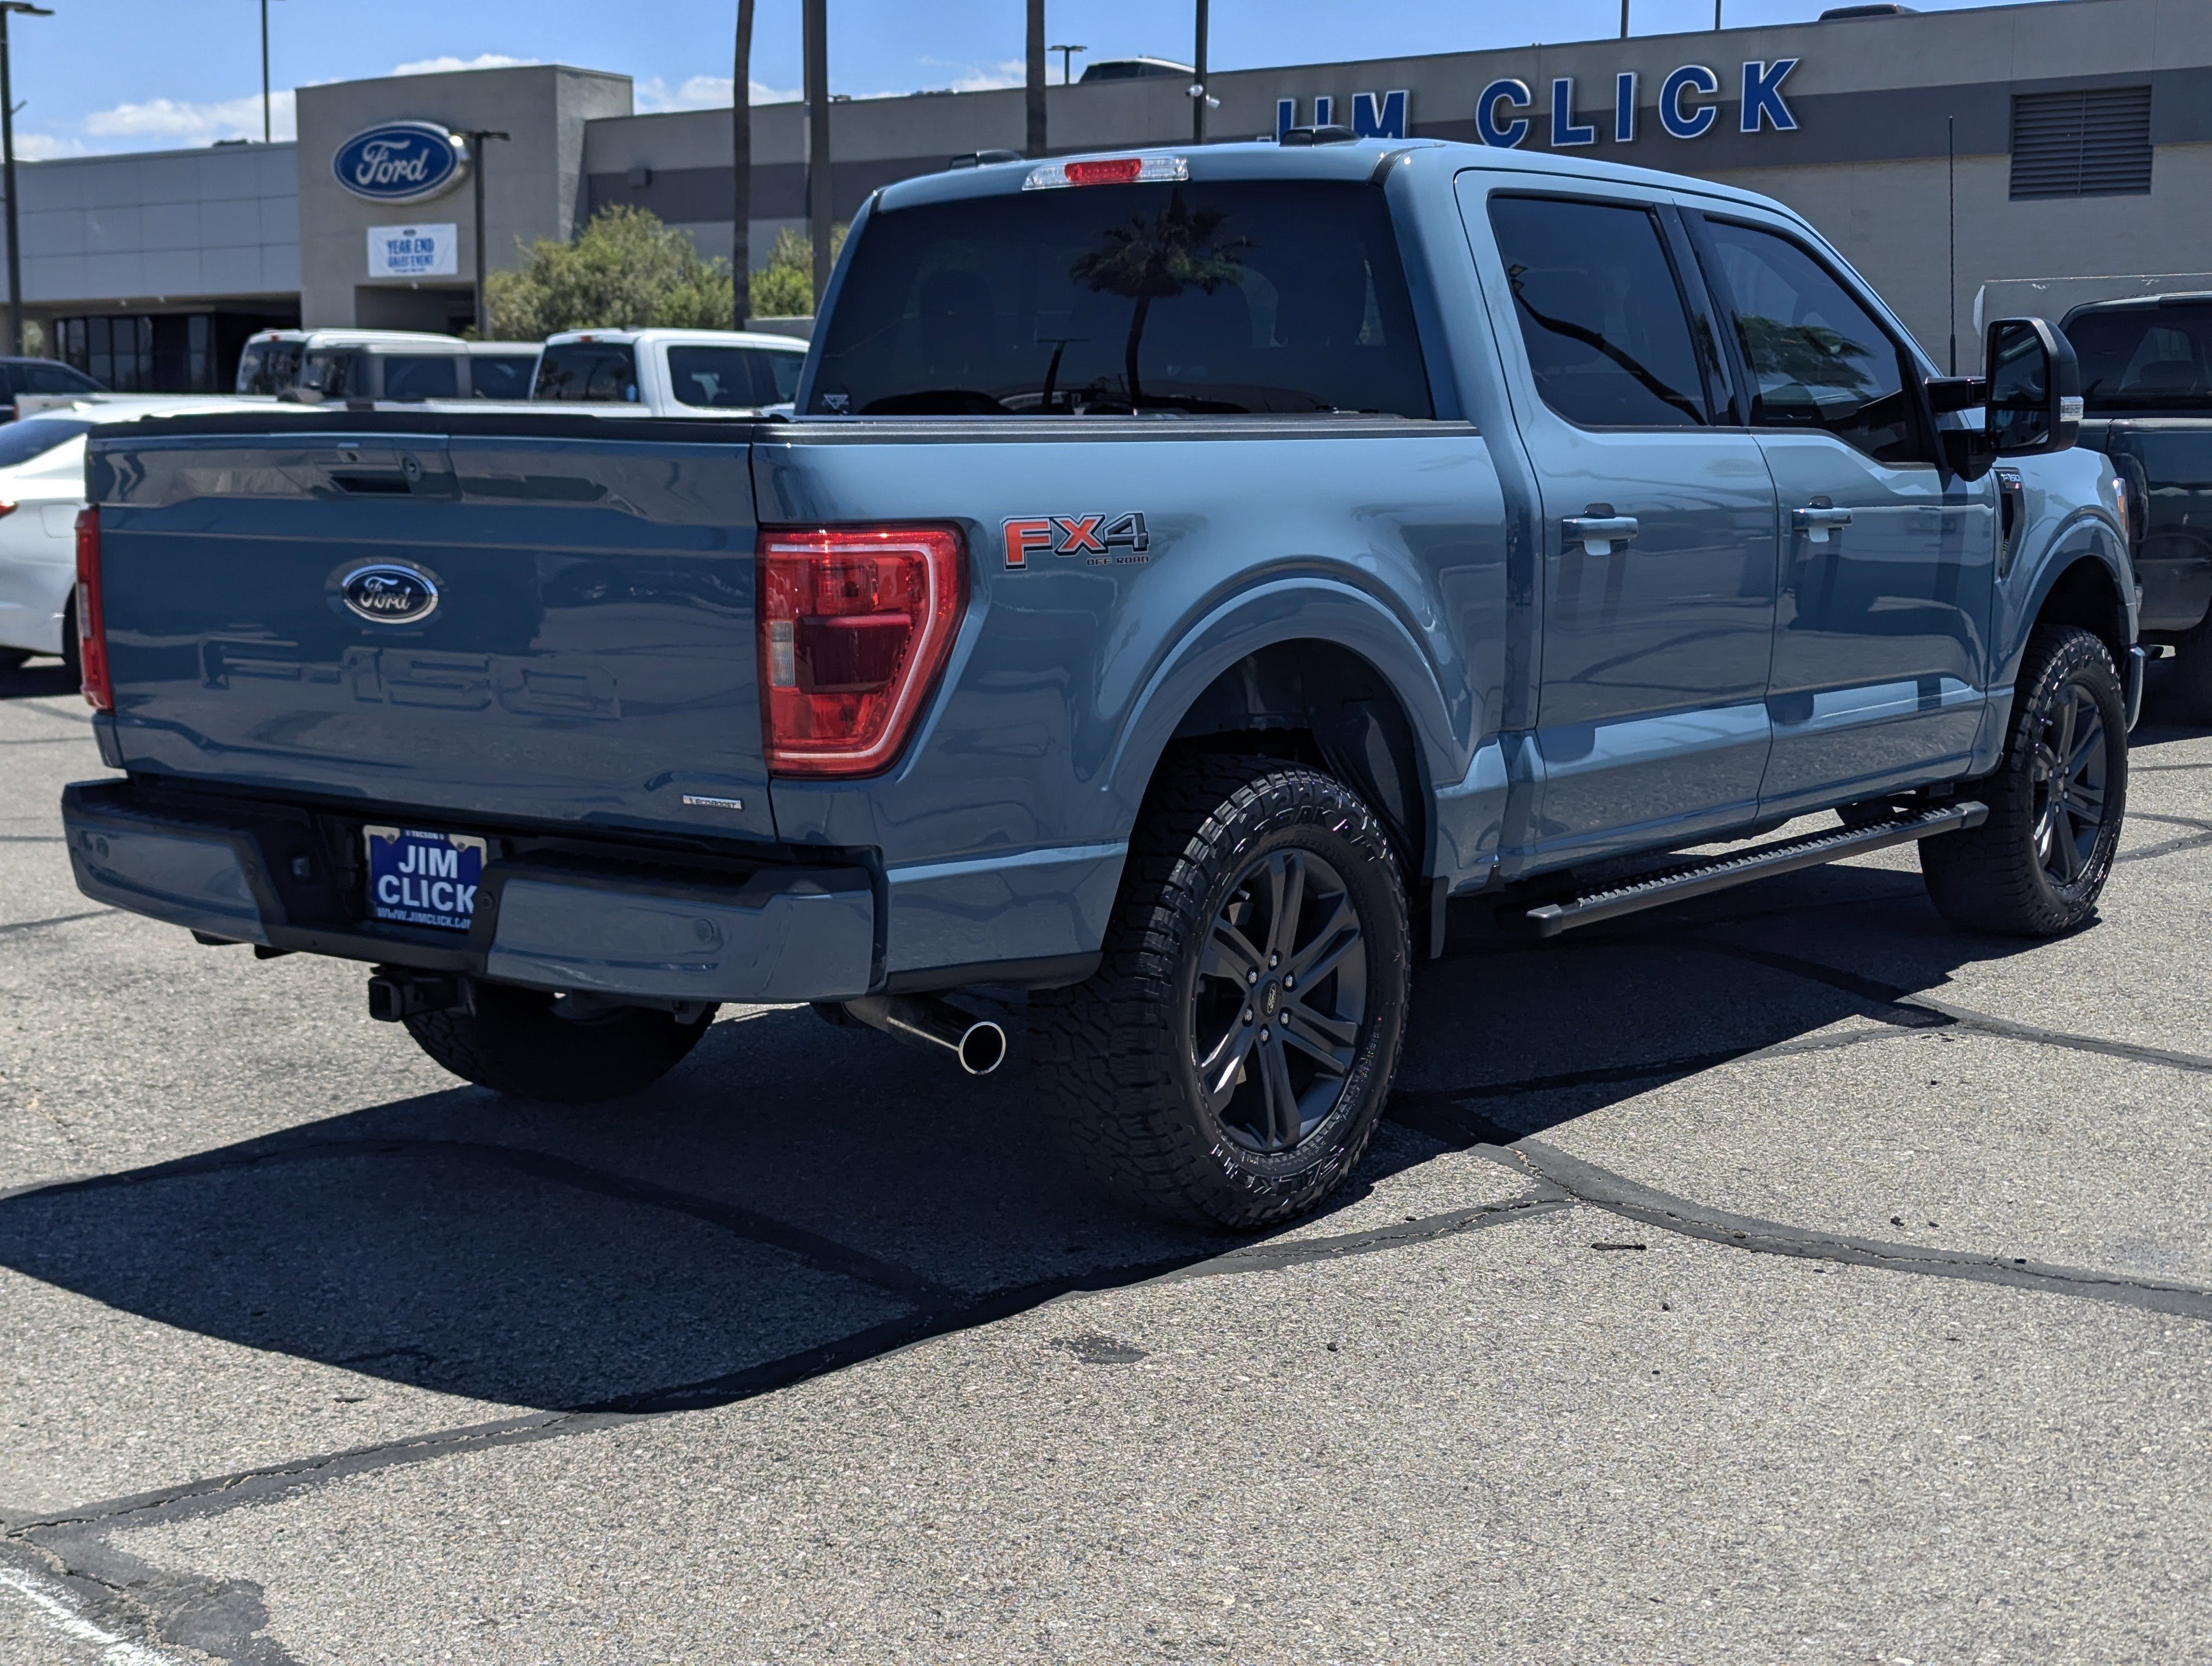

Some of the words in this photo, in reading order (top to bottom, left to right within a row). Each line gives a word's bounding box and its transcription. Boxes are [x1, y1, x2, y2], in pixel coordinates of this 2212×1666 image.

[1475, 57, 1800, 149] CLICK
[355, 139, 432, 185] Ford
[387, 239, 412, 255] YEAR
[414, 238, 435, 254] END
[1000, 511, 1150, 571] FX4
[1086, 557, 1112, 567] OFF
[1116, 555, 1149, 565] ROAD
[359, 576, 412, 610] Ford
[398, 845, 458, 879] JIM
[377, 874, 478, 914] CLICK
